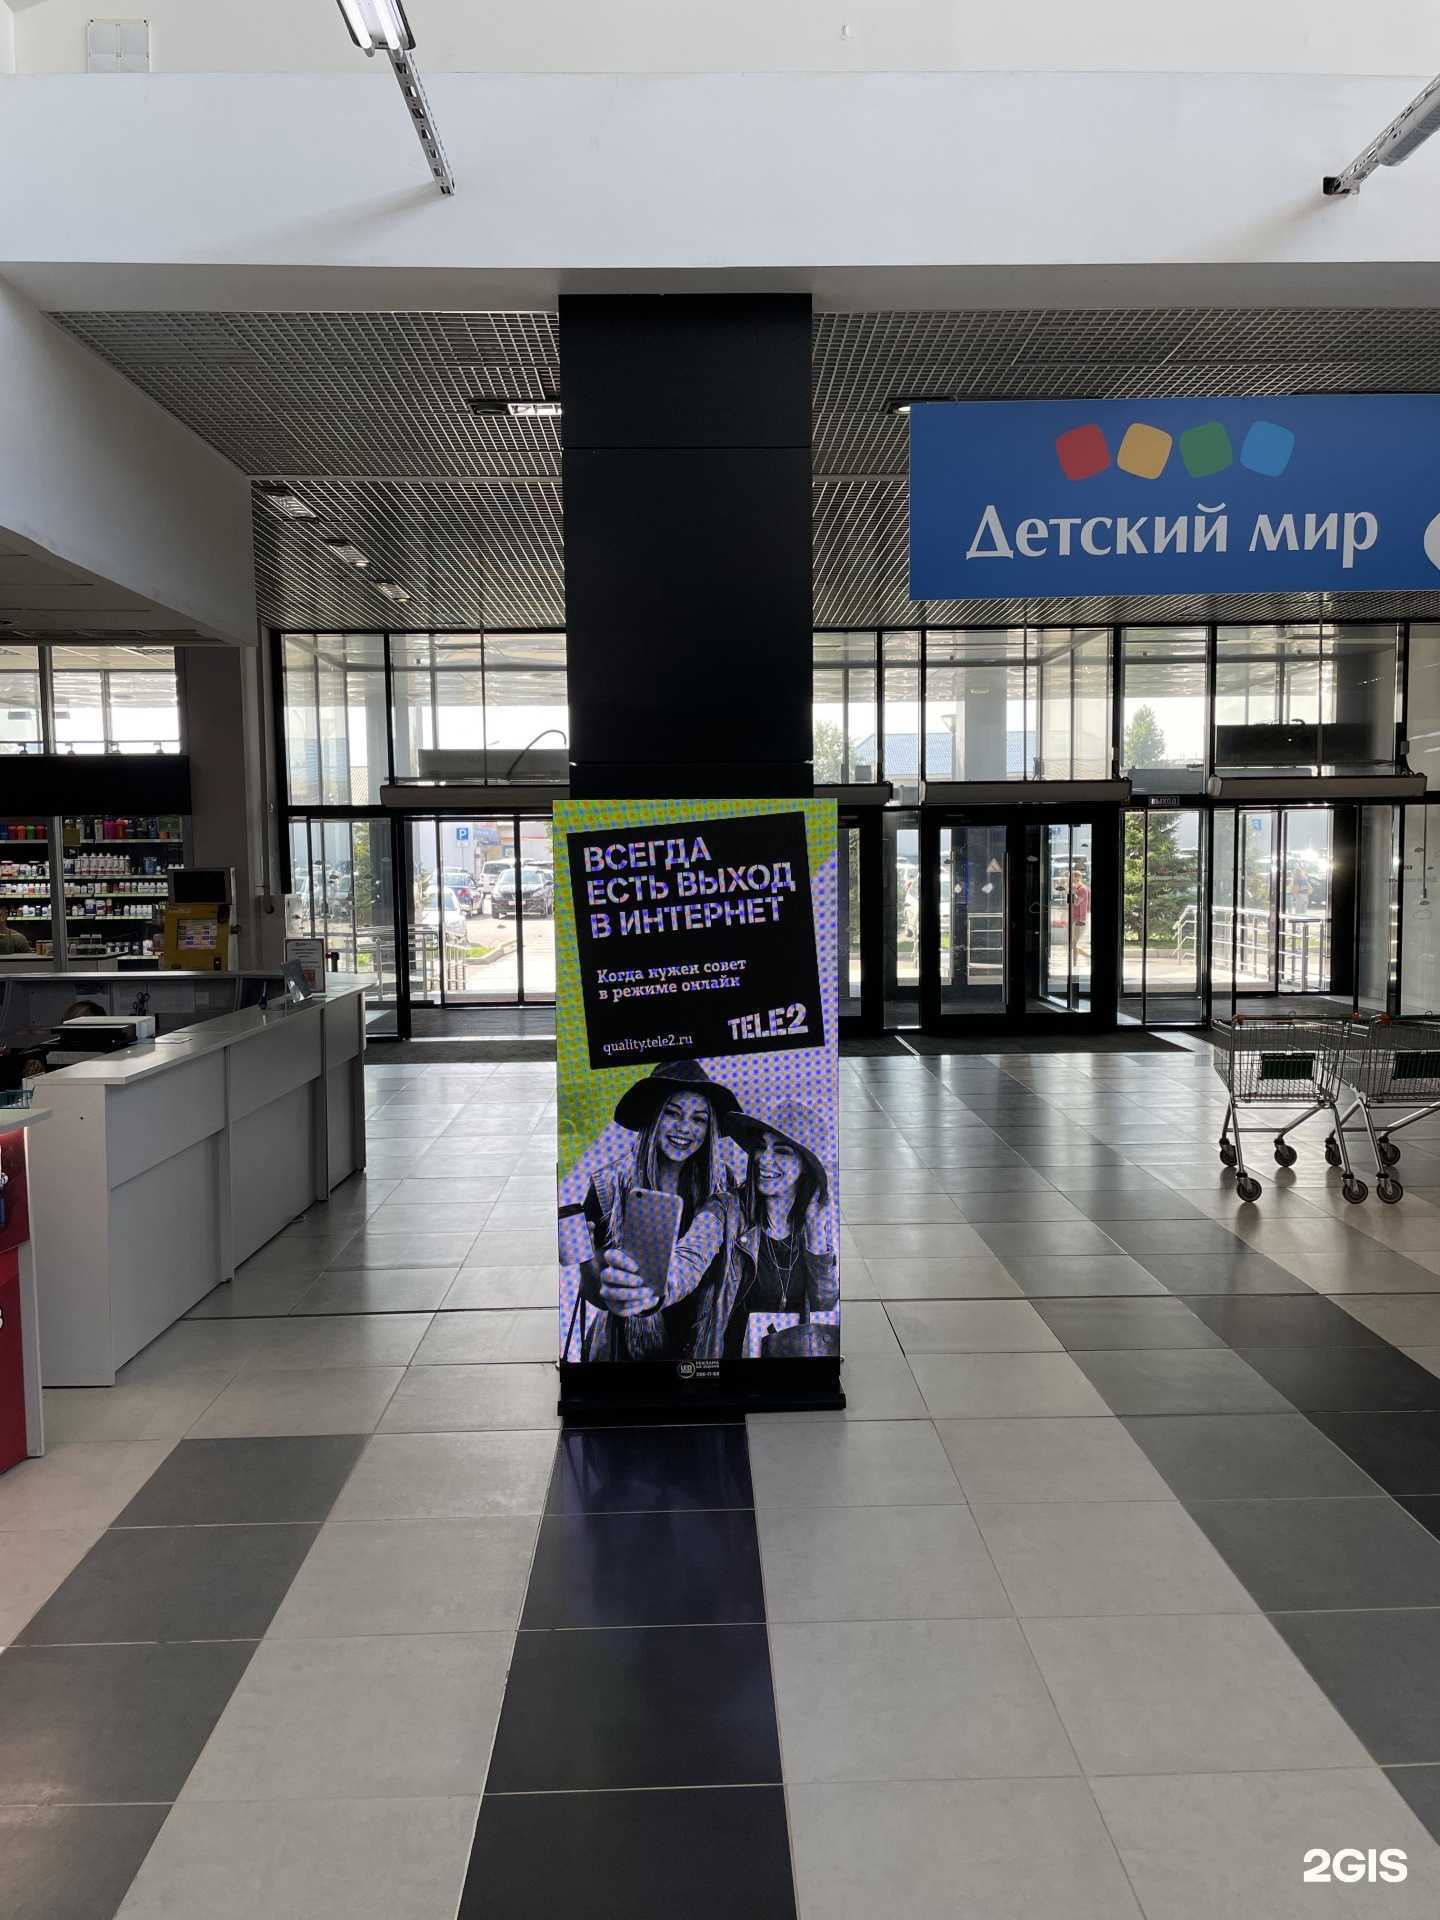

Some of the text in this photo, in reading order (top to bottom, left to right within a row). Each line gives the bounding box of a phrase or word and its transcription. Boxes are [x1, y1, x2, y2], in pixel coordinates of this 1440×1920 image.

[966, 502, 1379, 569] Детский мир
[583, 836, 712, 872] ВСЕГДА
[586, 862, 796, 905] ЕСТЬ ВЫХОД
[590, 896, 784, 939] В ИНТЕРНЕТ
[597, 959, 747, 983] Когда нужен совет
[598, 975, 741, 1002] в режиме онлайн
[727, 1003, 809, 1041] TELE2
[603, 1034, 694, 1056] quality.tele2.ru
